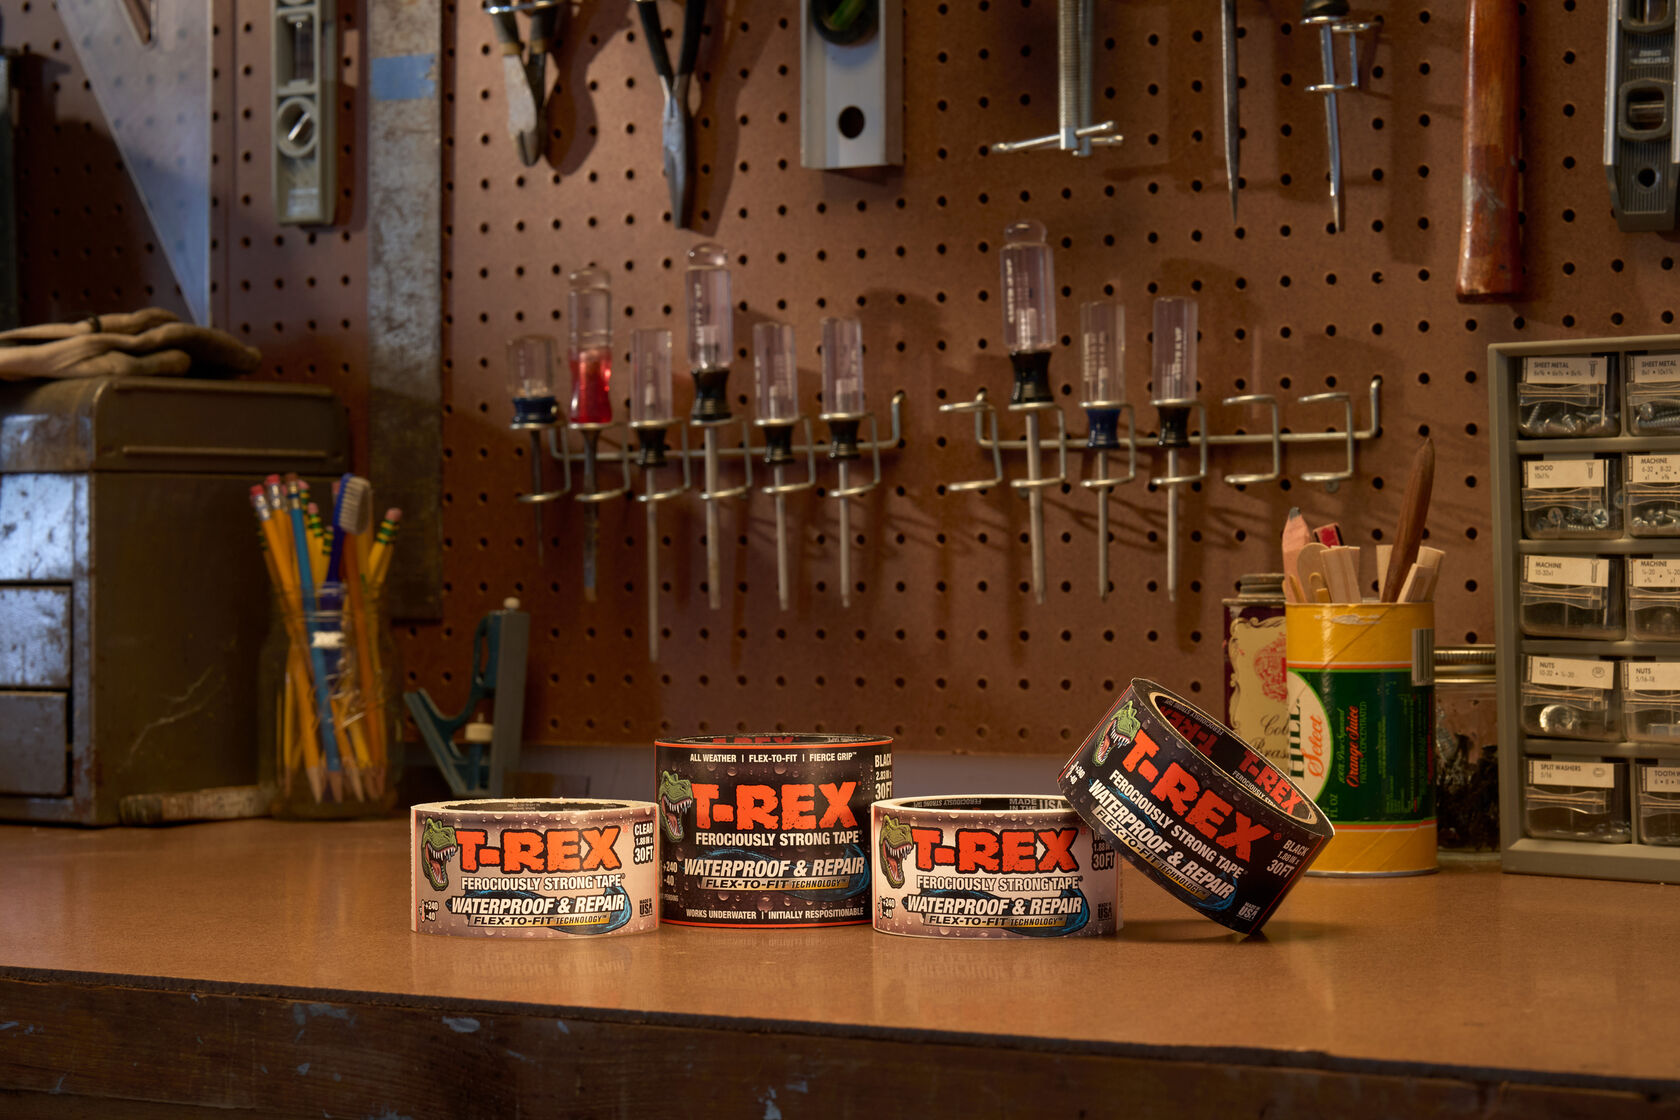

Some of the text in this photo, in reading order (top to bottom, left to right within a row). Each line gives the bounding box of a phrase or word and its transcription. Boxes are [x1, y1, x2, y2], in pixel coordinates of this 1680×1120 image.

[1300, 714, 1324, 779] Select
[1345, 705, 1364, 788] Orange Juice
[690, 754, 702, 762] ALL
[702, 754, 737, 762] WEATHER
[749, 754, 798, 763] FLEX-TO-FIT
[810, 752, 836, 762] FIERCE
[875, 754, 892, 768] BLACK
[875, 781, 892, 800] 30FT
[1040, 798, 1063, 810] USA
[1109, 769, 1174, 829] FEROCIOUSLY
[1170, 824, 1217, 862] STRONG
[634, 822, 653, 836] CLEAR
[696, 832, 776, 846] FEROCIOUSLY
[780, 832, 830, 846] STRONG
[1088, 779, 1236, 900] WATERPROOF & REPAIR
[1096, 809, 1160, 864] FLEX-TO-FIT
[634, 846, 654, 864] 30FT
[1283, 840, 1310, 857] BLACK
[663, 861, 678, 873] +240
[684, 857, 865, 877] WATERPROOF & REPAIR
[1092, 852, 1114, 868] 30FT
[1266, 859, 1296, 878] 30FT
[461, 876, 542, 890] FEROCIOUSLY
[544, 876, 593, 890] STRONG
[706, 880, 789, 888] FLEX-TO-FIT
[917, 875, 996, 891] FEROCIOUSLY
[998, 876, 1050, 891] STRONG
[426, 901, 439, 910] +240
[452, 894, 625, 914] WATERPROOF & REPAIR
[640, 903, 652, 915] USA
[908, 895, 1082, 915] WATERPROOF & REPAIR
[426, 912, 436, 921] -40
[686, 907, 864, 919] WORKS UNDERWATER INITIALLY RESPOSITIONABLE
[1098, 907, 1112, 918] USA
[1238, 905, 1259, 920] USA
[474, 916, 554, 925] FLEX-TO-FIT
[929, 916, 1008, 926] FLEX-TO-FIT
